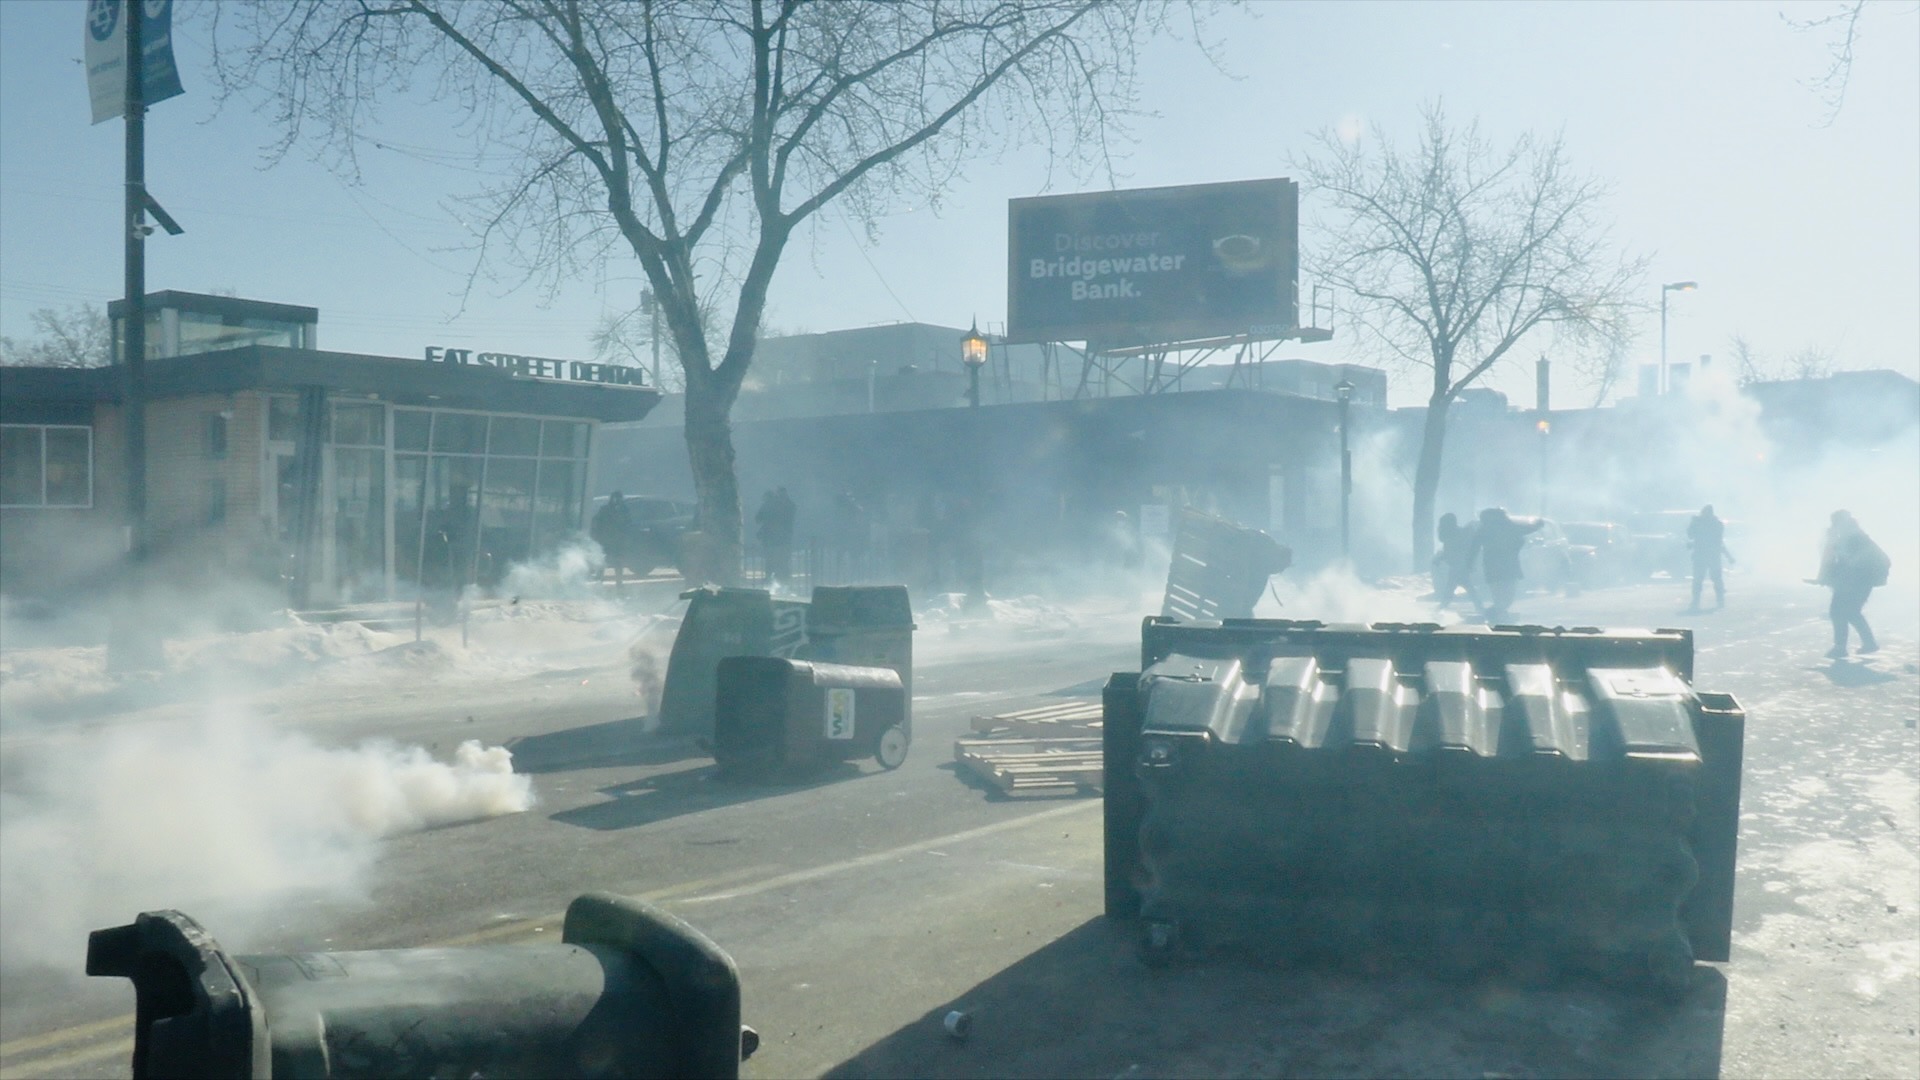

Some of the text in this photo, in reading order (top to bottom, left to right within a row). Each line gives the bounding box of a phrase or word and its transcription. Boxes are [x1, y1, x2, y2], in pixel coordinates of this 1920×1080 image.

[1055, 231, 1161, 252] Discover
[1030, 253, 1186, 280] Bridgewater
[1071, 278, 1142, 301] Bank.
[425, 346, 473, 367] EAT
[477, 352, 567, 379] STREET
